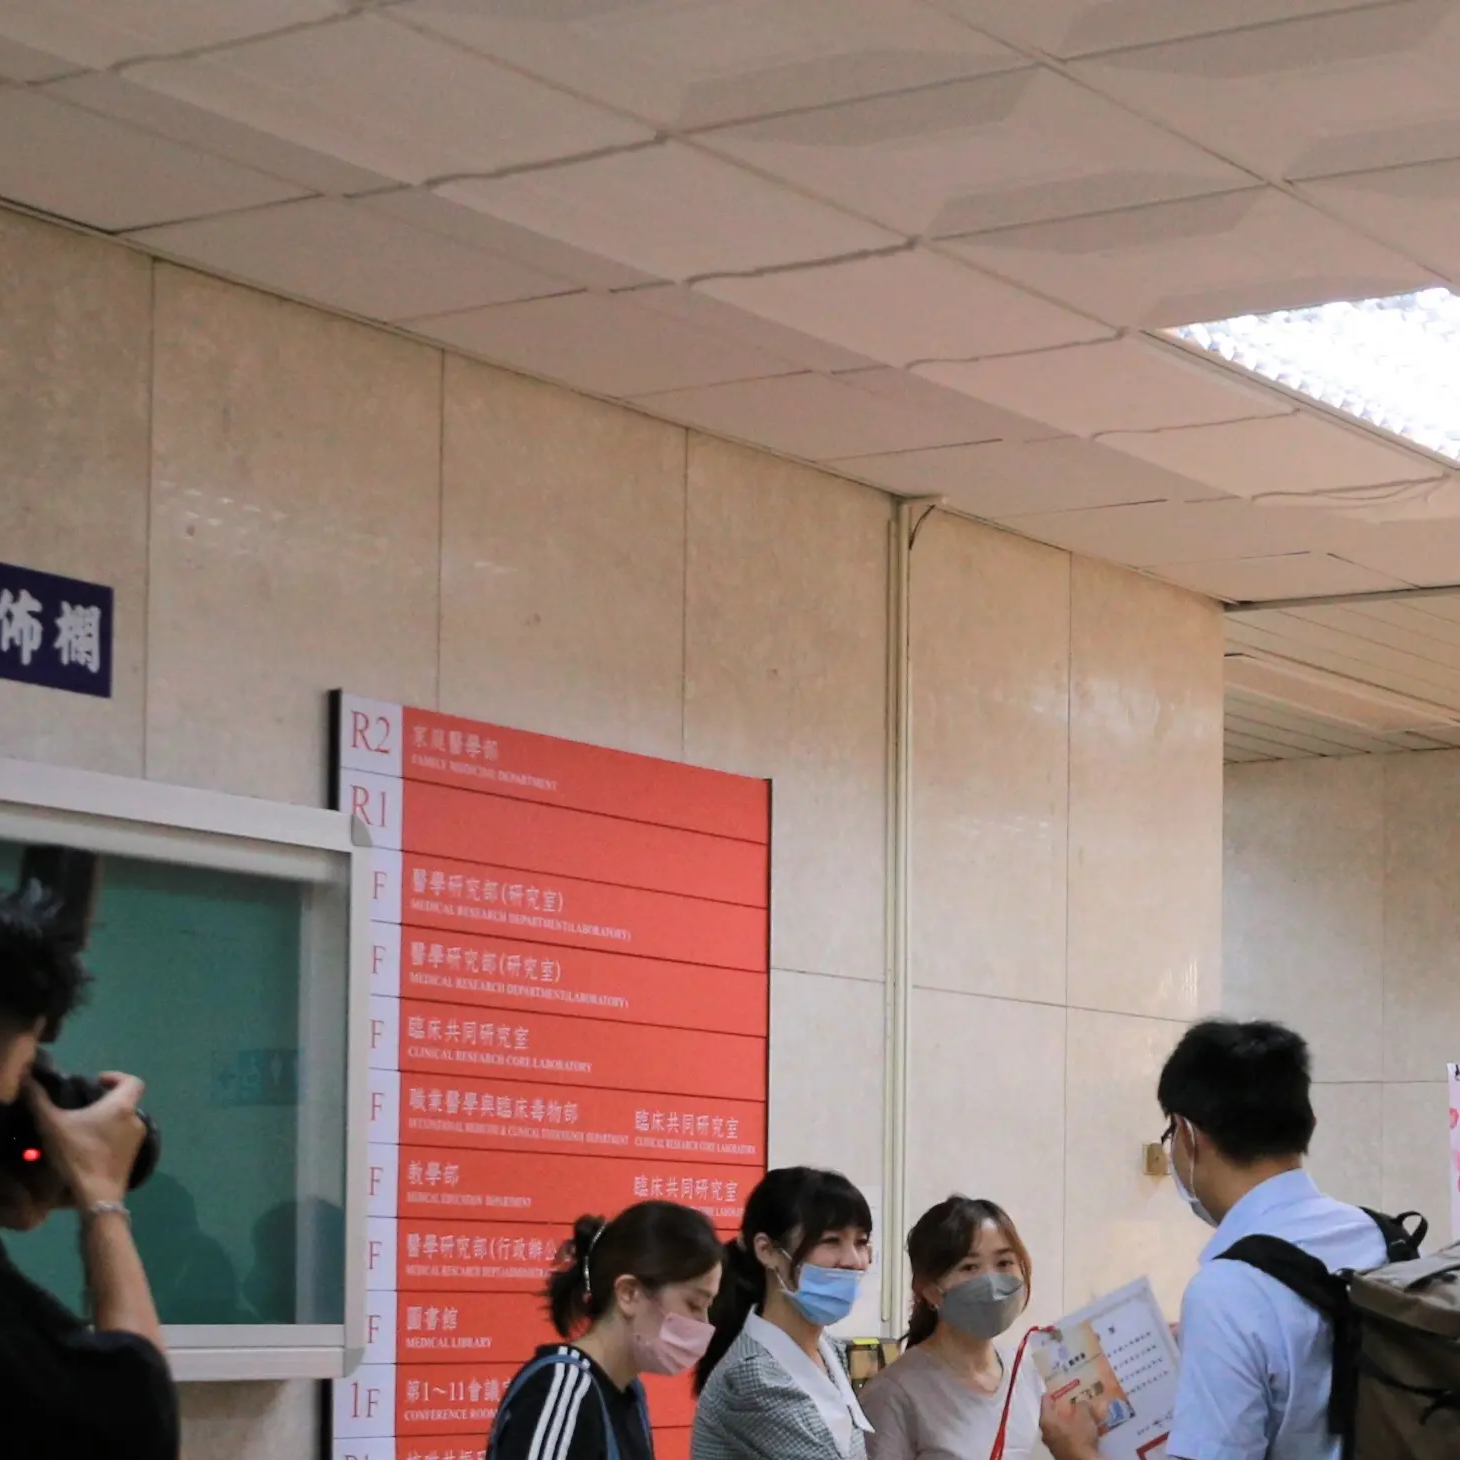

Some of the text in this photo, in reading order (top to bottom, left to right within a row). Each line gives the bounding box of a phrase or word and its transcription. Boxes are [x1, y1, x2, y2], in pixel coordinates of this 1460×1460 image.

[351, 710, 390, 754] R2
[350, 784, 388, 828] R1
[412, 868, 564, 913] 醫學研究部(研究室)
[411, 899, 455, 916] MEDICAL
[457, 905, 506, 923] RESEARCH
[410, 941, 561, 983] 醫學研究部(研究室)
[409, 972, 453, 988] MEDICAL
[408, 1016, 530, 1050] 臨床共同研究室
[408, 1047, 454, 1061] CLINICAL
[456, 1050, 505, 1065] RESEARCH
[634, 1109, 739, 1140] 臨床共同研究室
[407, 1161, 459, 1187] 教學部
[633, 1173, 738, 1202] 臨床共同研究室
[406, 1306, 459, 1331] 圖書館
[405, 1335, 492, 1348] MEDICAL LIBRARY
[351, 1381, 381, 1418] 1F
[404, 1408, 468, 1421] CONFERENCE
